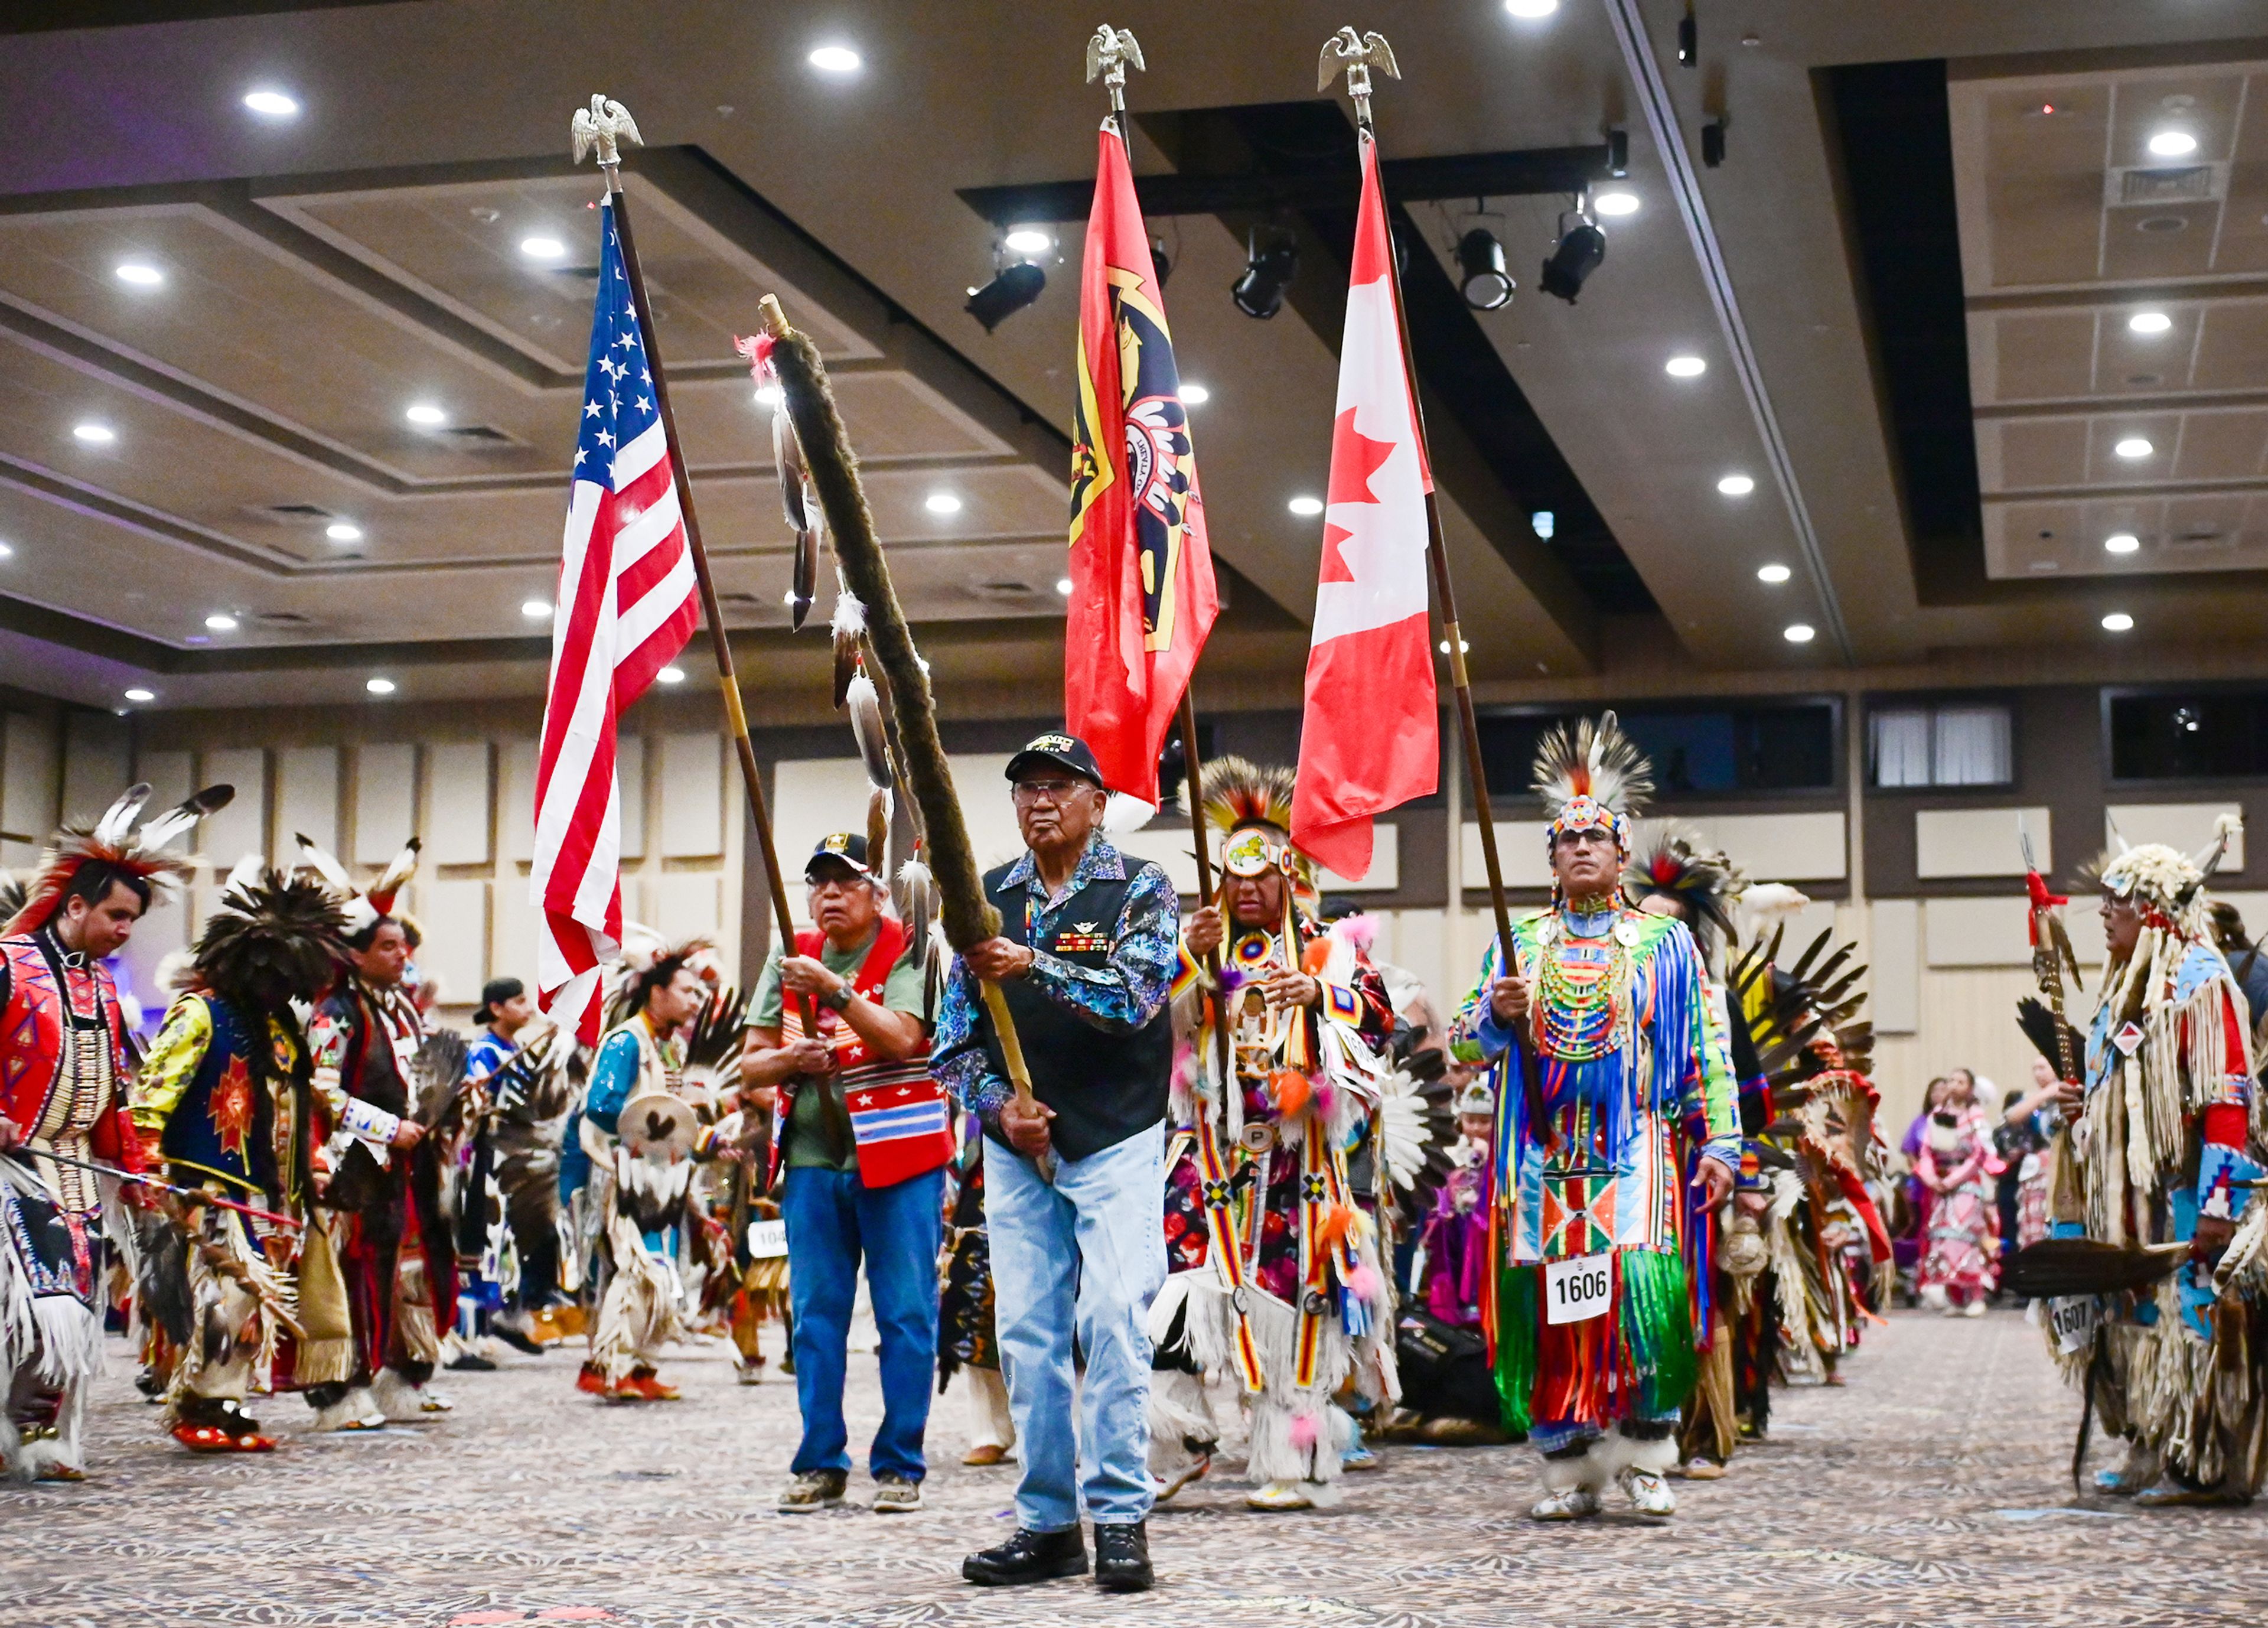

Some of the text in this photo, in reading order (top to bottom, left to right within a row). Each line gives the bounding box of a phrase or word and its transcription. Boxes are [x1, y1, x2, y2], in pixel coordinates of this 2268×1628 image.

[1252, 1131, 1263, 1144] P
[1556, 1270, 1606, 1305] 1606
[2054, 1302, 2086, 1336] 1607
